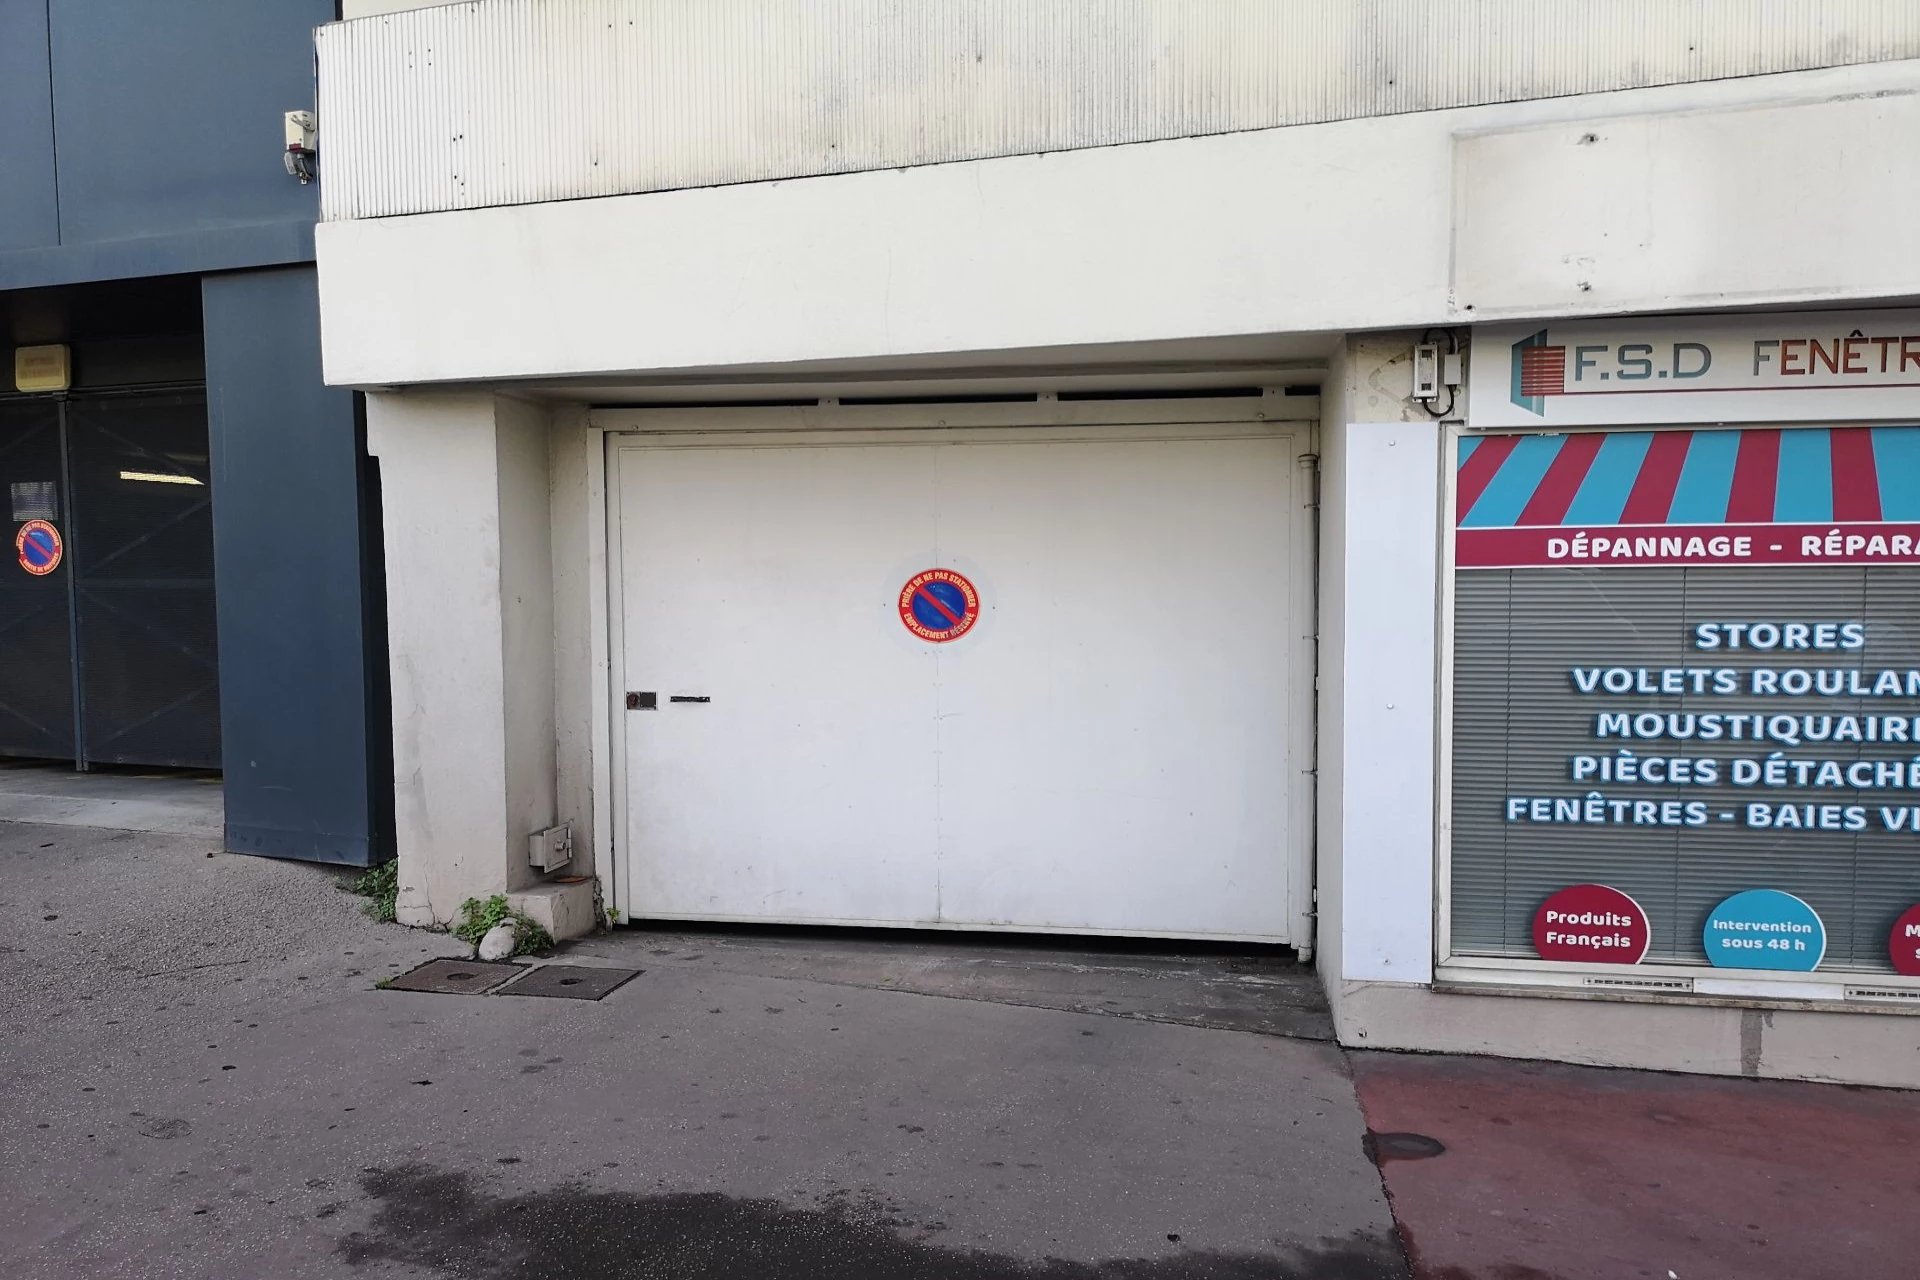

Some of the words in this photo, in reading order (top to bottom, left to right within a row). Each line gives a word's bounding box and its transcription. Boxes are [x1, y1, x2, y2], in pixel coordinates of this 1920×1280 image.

[1575, 342, 1712, 381] F.S.D
[1547, 532, 1752, 559] DÉPANNAGE
[913, 577, 924, 587] DE
[923, 572, 933, 581] NE
[934, 571, 949, 580] PAS
[903, 612, 949, 639] EMPLACEMENT
[1696, 623, 1866, 650] STORES
[1574, 667, 1737, 695] VOLETS
[1572, 749, 1719, 785] PIÈCES
[1506, 791, 1709, 826] FENÊTRES
[1746, 802, 1868, 832] BAIES
[1546, 910, 1632, 928] Produits
[1713, 918, 1812, 935] Intervention
[1546, 931, 1631, 949] Français
[1721, 938, 1764, 951] sous
[1767, 936, 1791, 951] 48
[1794, 937, 1806, 952] h
